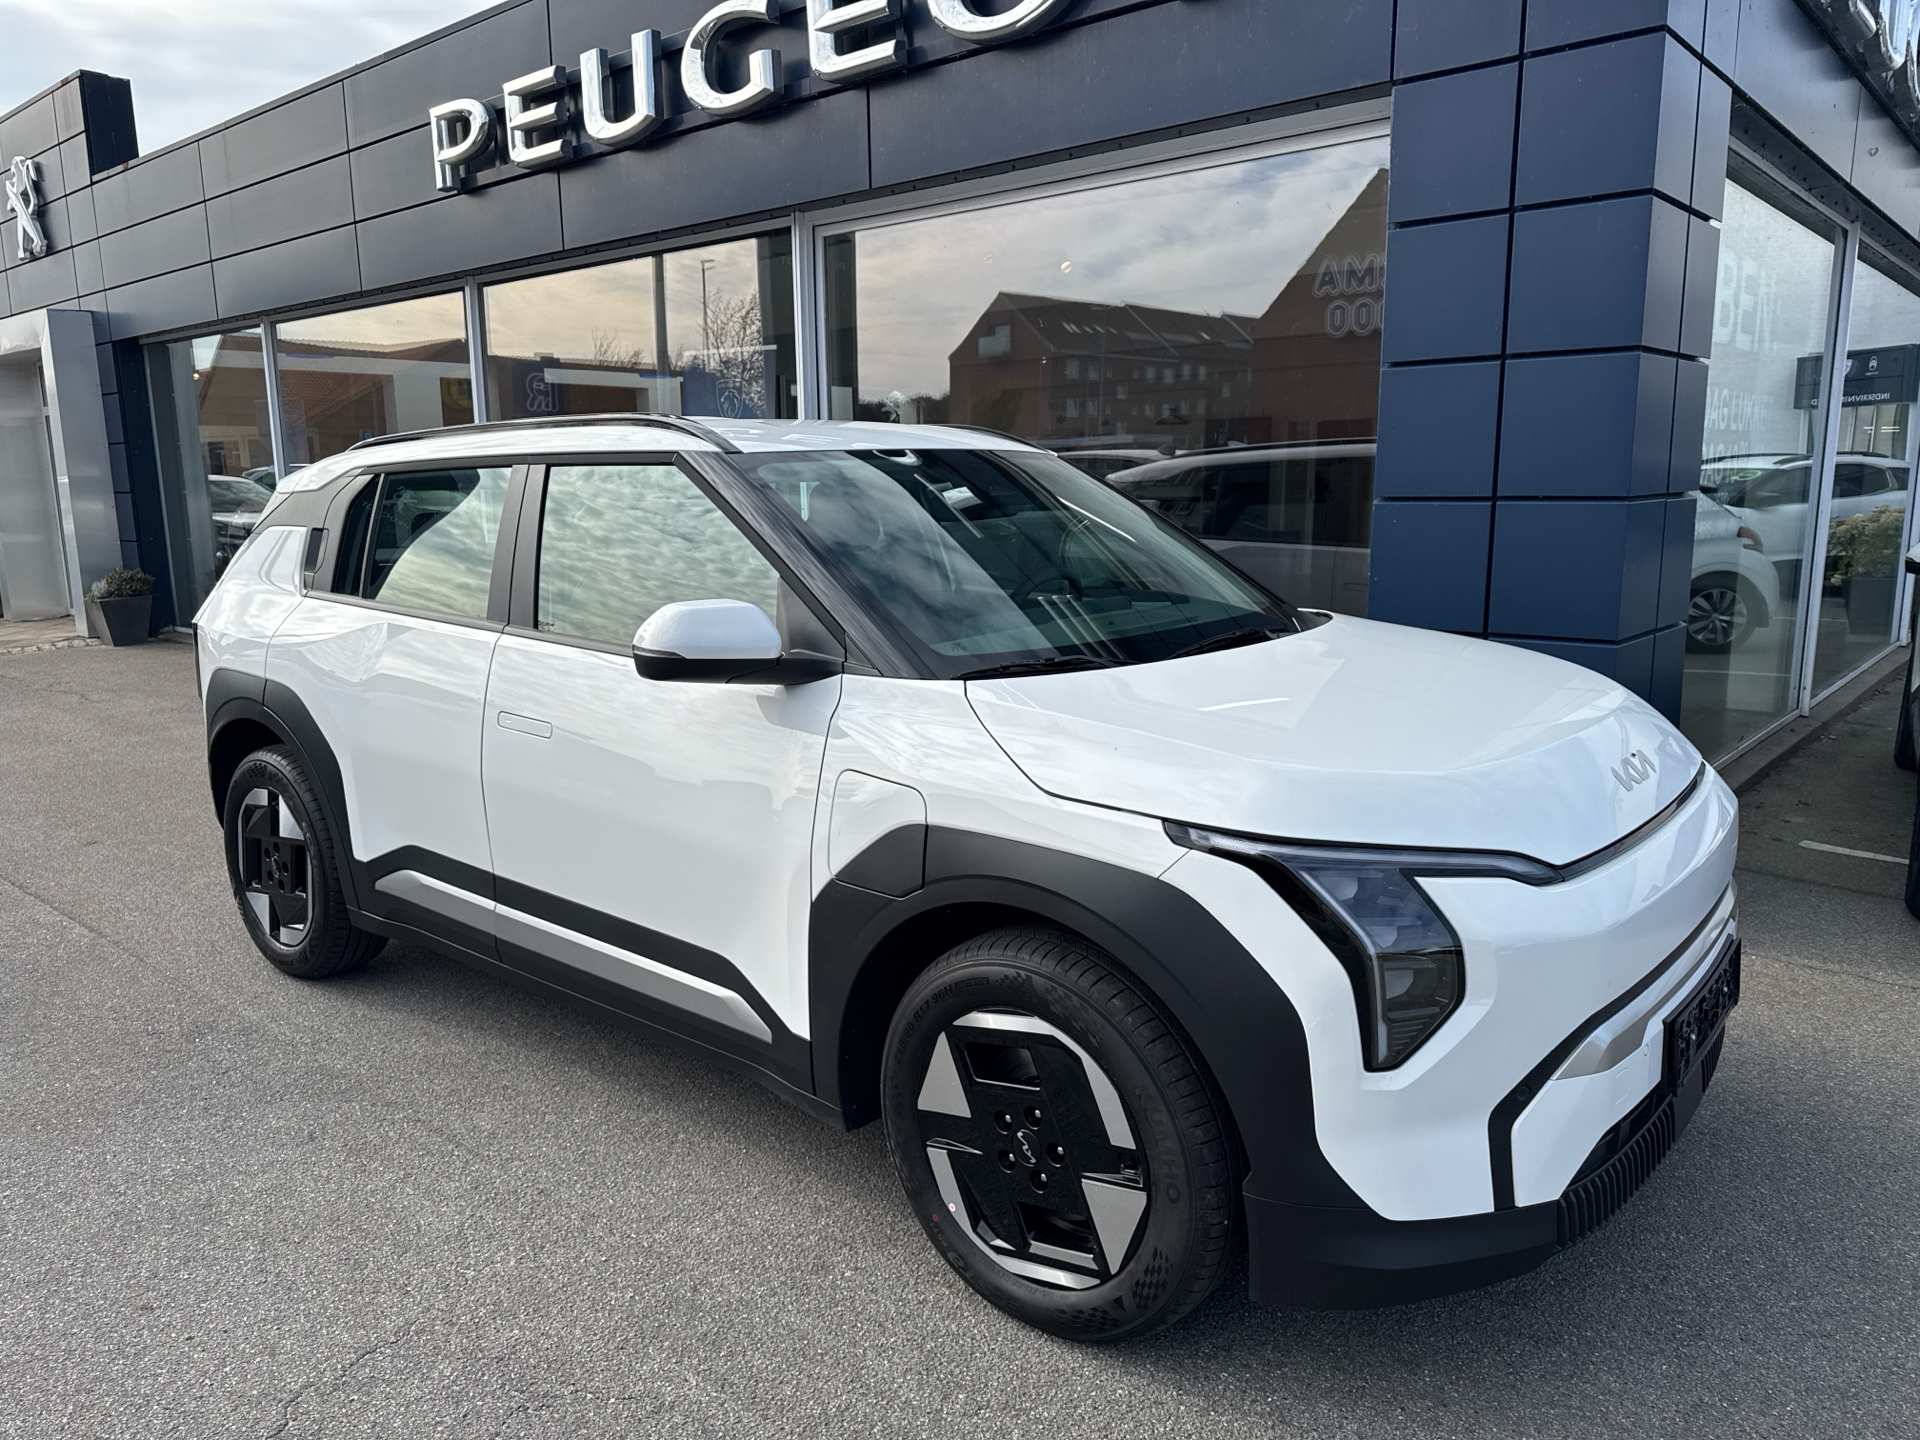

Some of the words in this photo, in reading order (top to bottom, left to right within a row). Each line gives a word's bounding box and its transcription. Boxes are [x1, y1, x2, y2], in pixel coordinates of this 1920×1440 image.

[1611, 749, 1656, 792] KIA
[894, 1021, 914, 1065] 215/60
[913, 1000, 931, 1023] R17
[932, 984, 953, 1004] 96H
[1134, 1083, 1181, 1205] KUMHO
